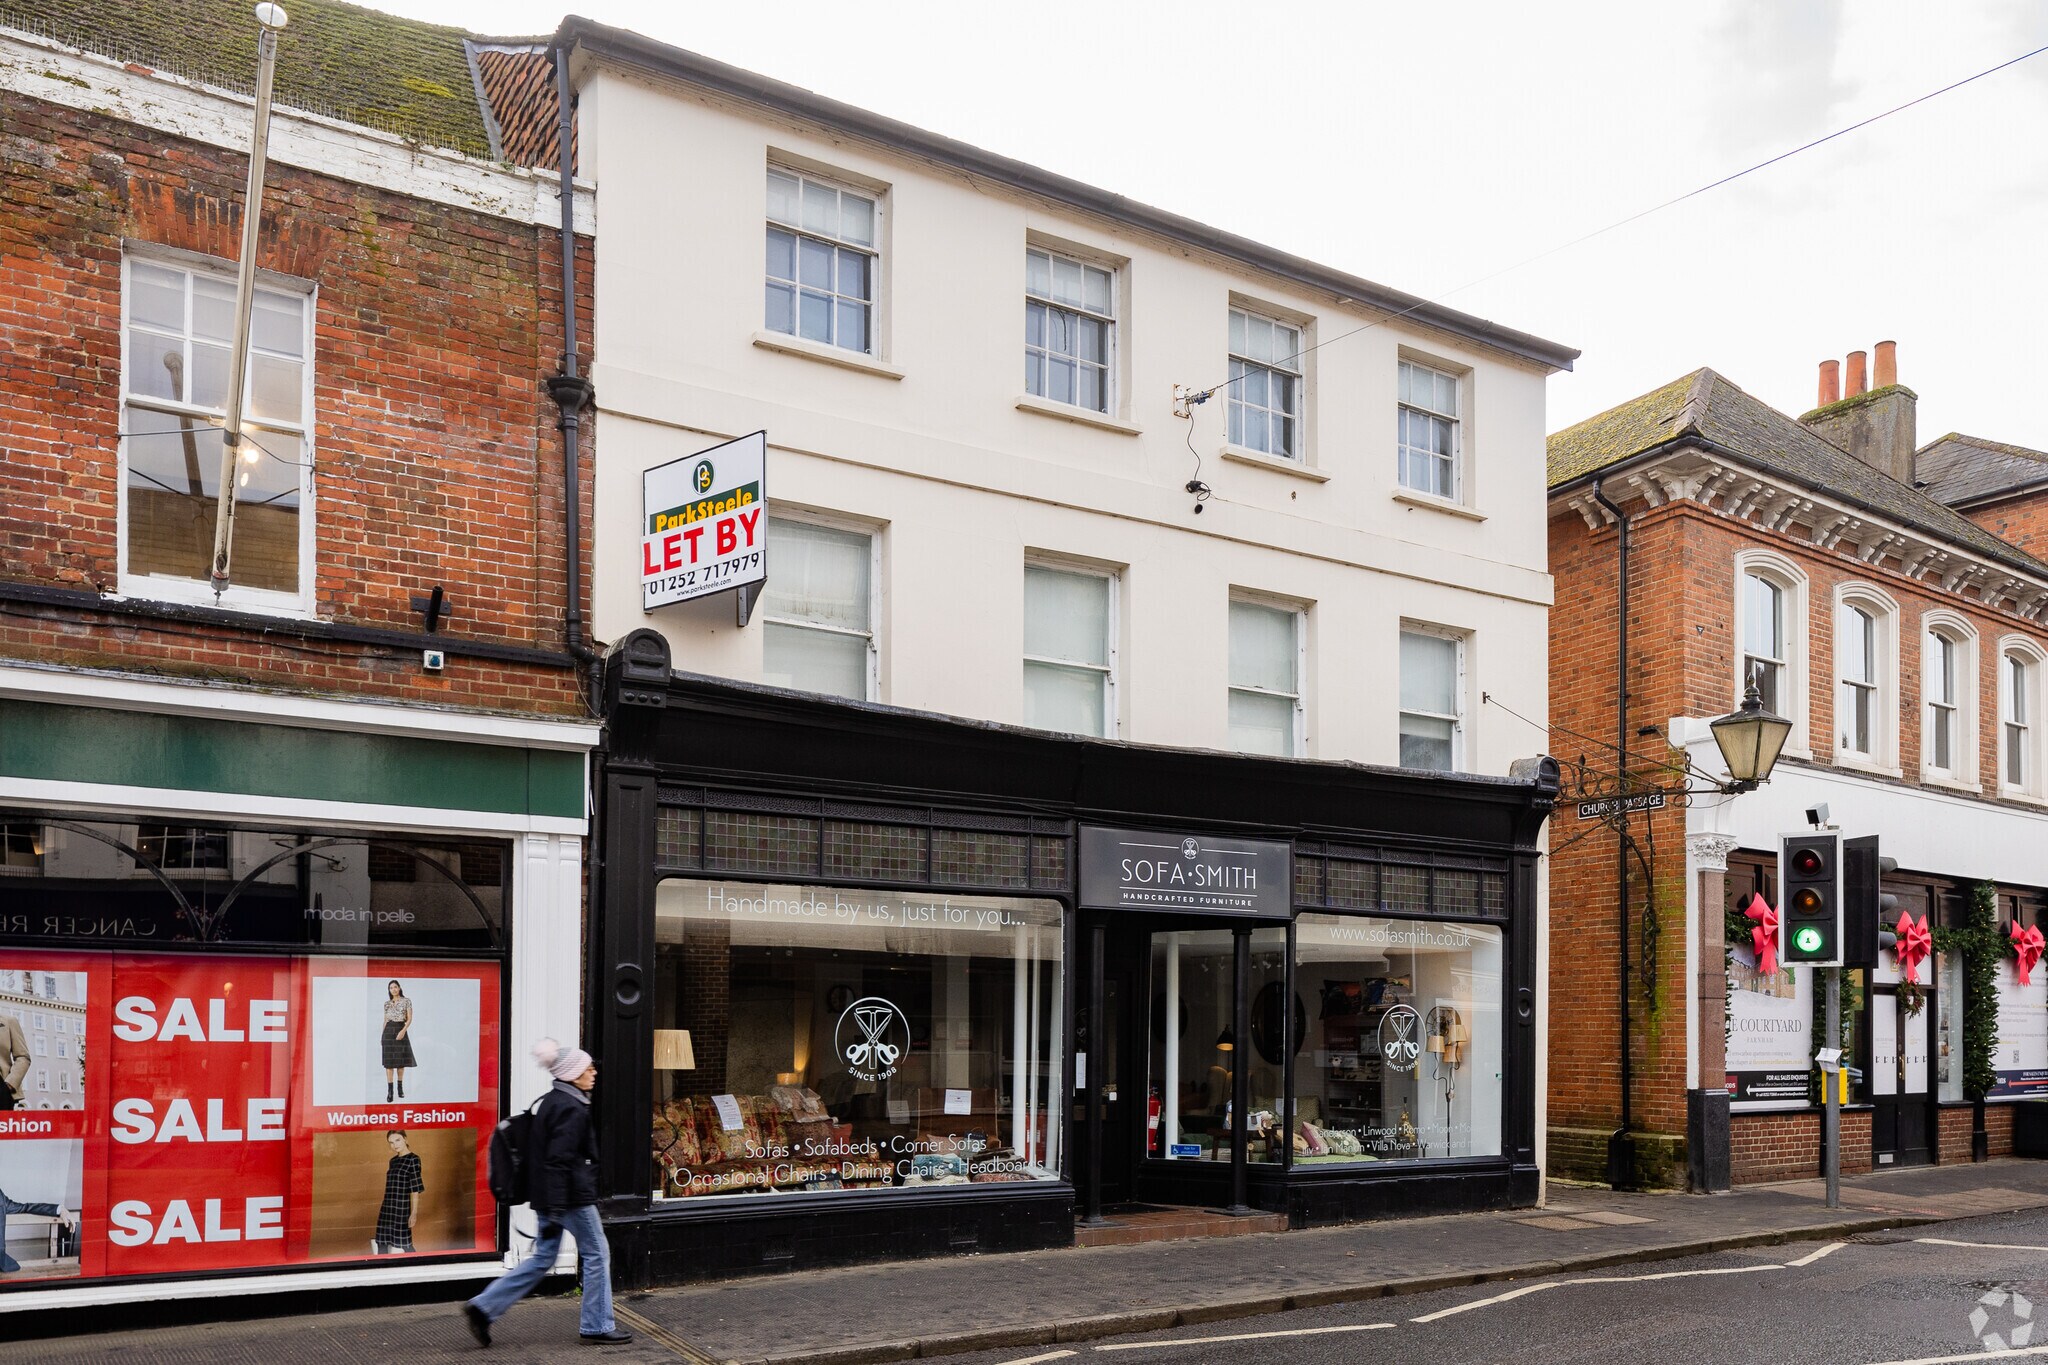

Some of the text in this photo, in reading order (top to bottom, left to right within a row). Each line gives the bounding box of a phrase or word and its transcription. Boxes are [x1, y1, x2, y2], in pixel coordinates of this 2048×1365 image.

[656, 488, 753, 533] ParkSteele
[643, 507, 761, 577] LET BY
[650, 553, 759, 594] 01252 717979
[677, 578, 732, 596] www.parksteele.com
[707, 887, 1026, 930] Handmade by us, just for you...
[1123, 892, 1252, 906] HANDCRAFTED FURNITURE
[304, 907, 415, 926] moda in pelle
[1330, 924, 1471, 947] www.sofasmith.co.uk
[112, 996, 288, 1043] SALE
[1740, 1019, 1802, 1032] COURTYARD
[848, 1066, 897, 1081] SINCE 1908
[1386, 1060, 1404, 1072] SINCE
[110, 1097, 285, 1145] SALE
[327, 1109, 466, 1126] Womens Fashion
[1363, 1124, 1397, 1136] Linwood
[744, 1133, 987, 1159] Sofas Sofabeds Corner Sofas
[1371, 1140, 1389, 1151] Villa
[1390, 1139, 1411, 1150] Nova
[674, 1166, 769, 1188] Occasional
[774, 1163, 827, 1182] Chairs
[842, 1161, 893, 1184] Dining
[897, 1159, 945, 1178] Chairs
[108, 1196, 283, 1247] SALE
